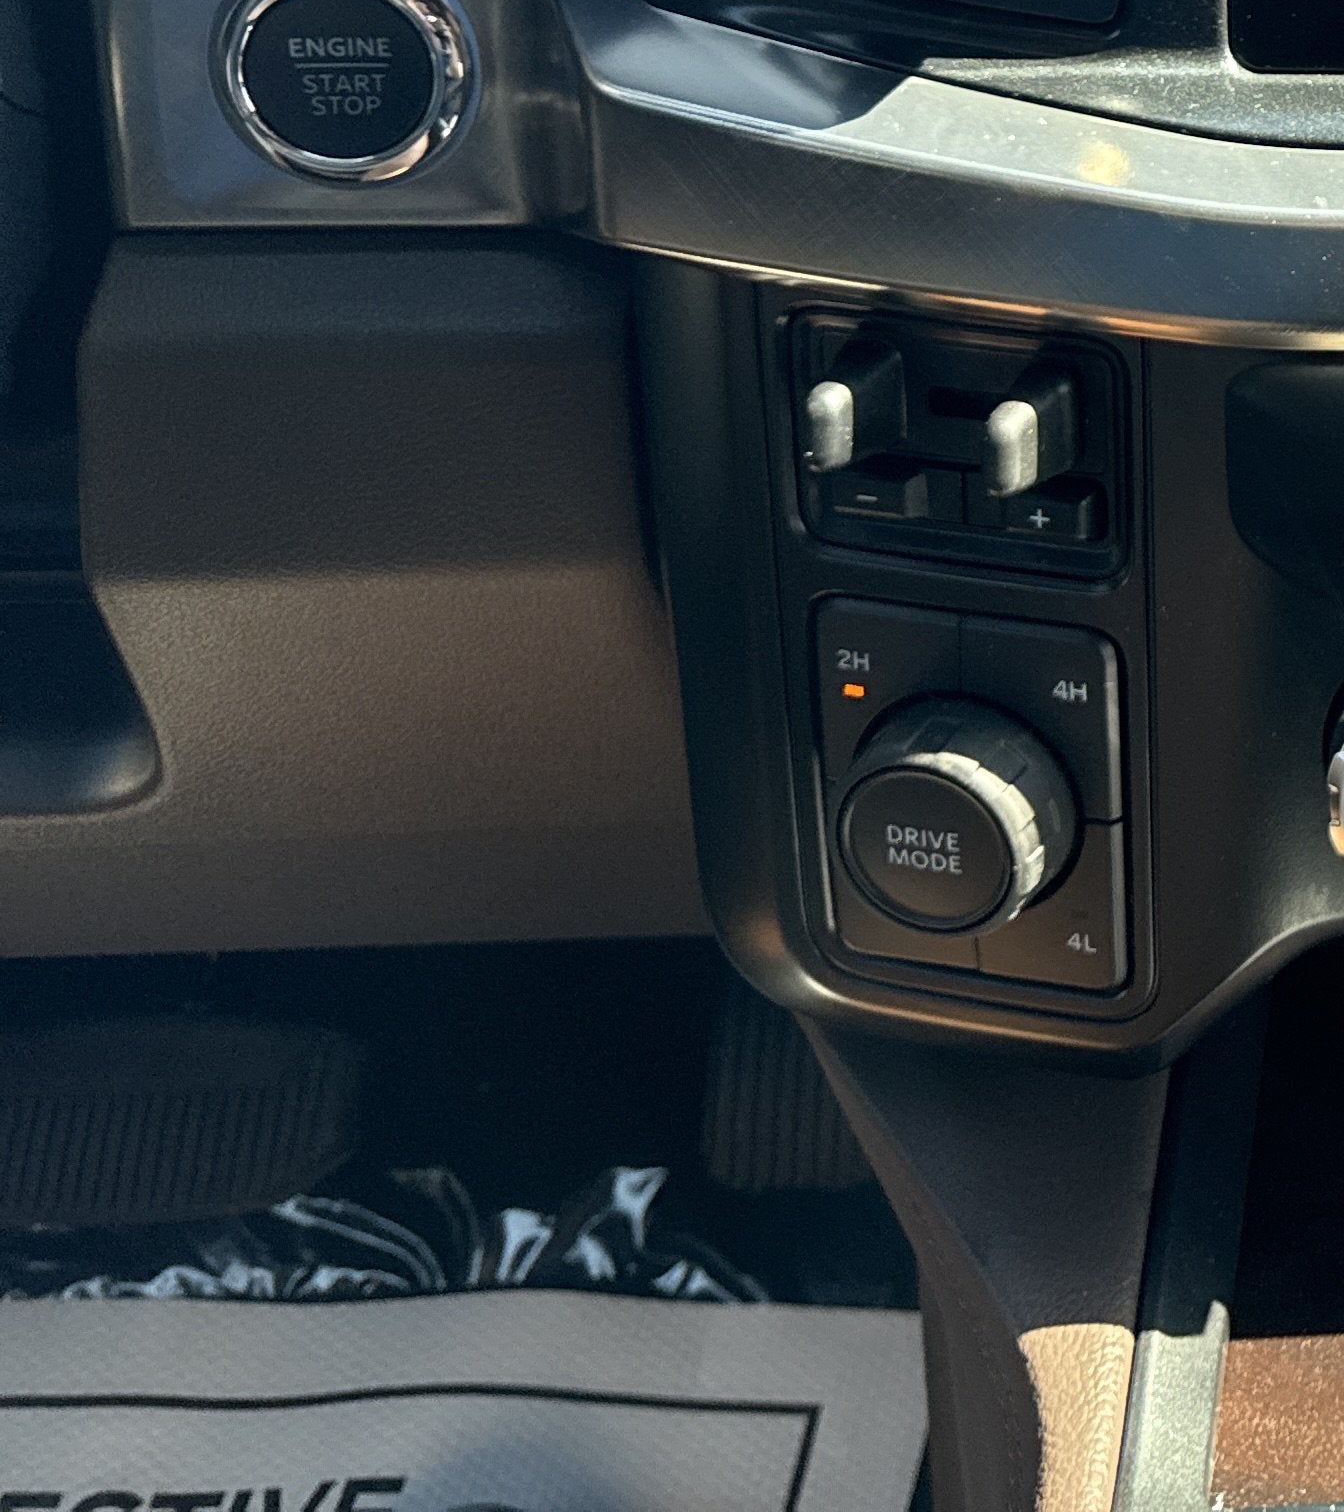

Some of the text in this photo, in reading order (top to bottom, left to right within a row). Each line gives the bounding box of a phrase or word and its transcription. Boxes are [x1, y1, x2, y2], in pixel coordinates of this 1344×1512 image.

[289, 37, 392, 57] ENGINE
[303, 73, 386, 94] START
[312, 96, 382, 115] STOP
[837, 649, 870, 671] 2H
[1052, 680, 1087, 702] 4H
[886, 824, 960, 852] DRIVE
[888, 847, 963, 875] MODE
[1067, 933, 1097, 954] 4L
